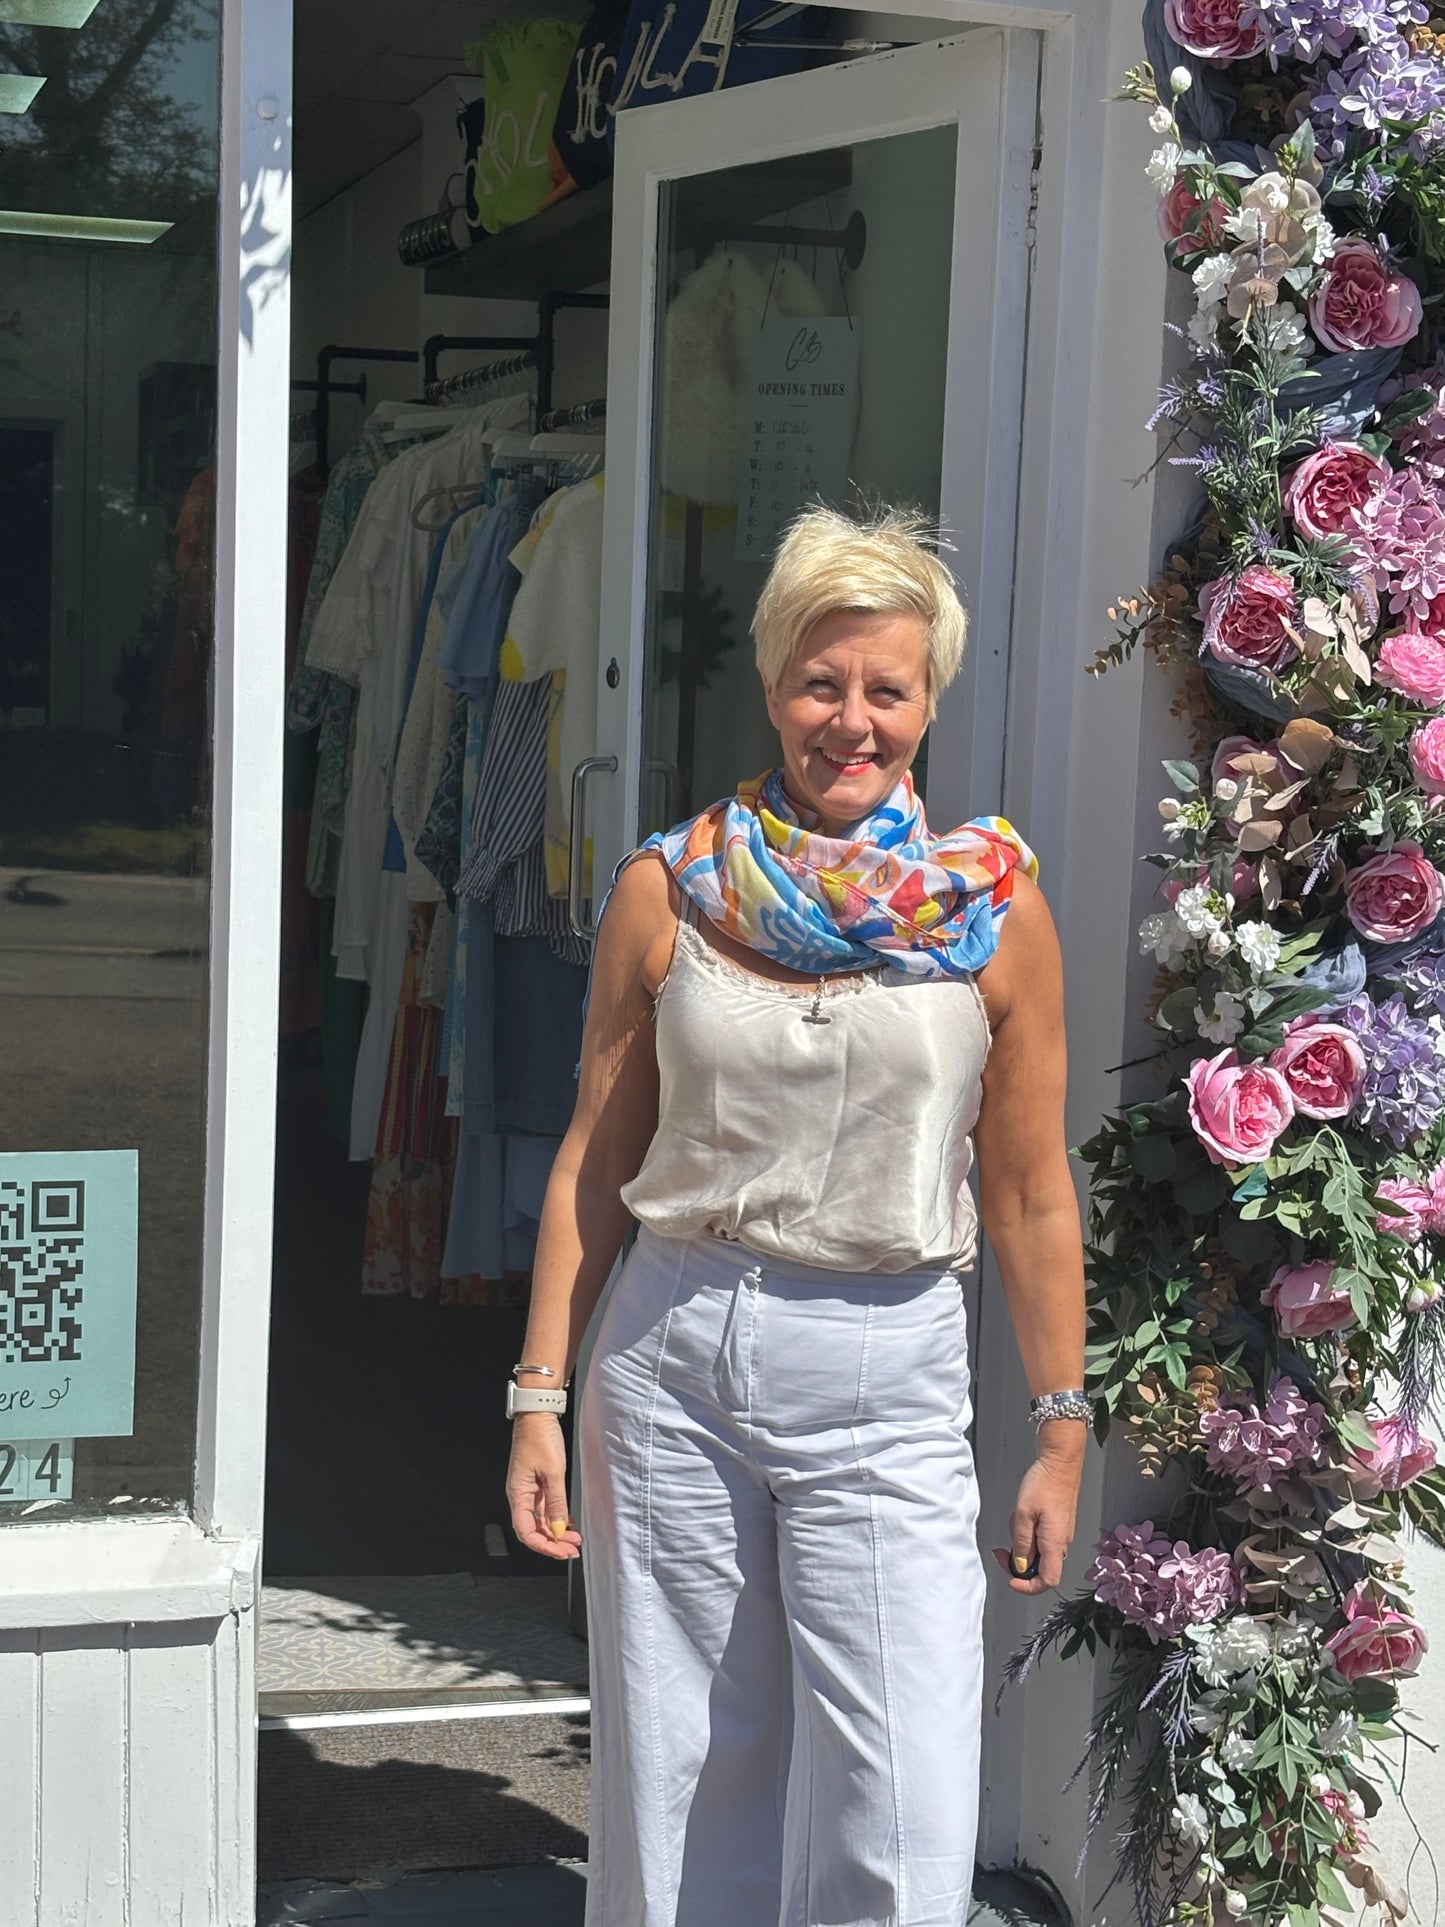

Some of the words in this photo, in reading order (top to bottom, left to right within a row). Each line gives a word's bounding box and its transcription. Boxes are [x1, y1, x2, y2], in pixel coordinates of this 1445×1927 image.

[757, 383, 806, 396] OPENING
[810, 383, 846, 396] TIMES
[0, 1442, 62, 1494] 24
